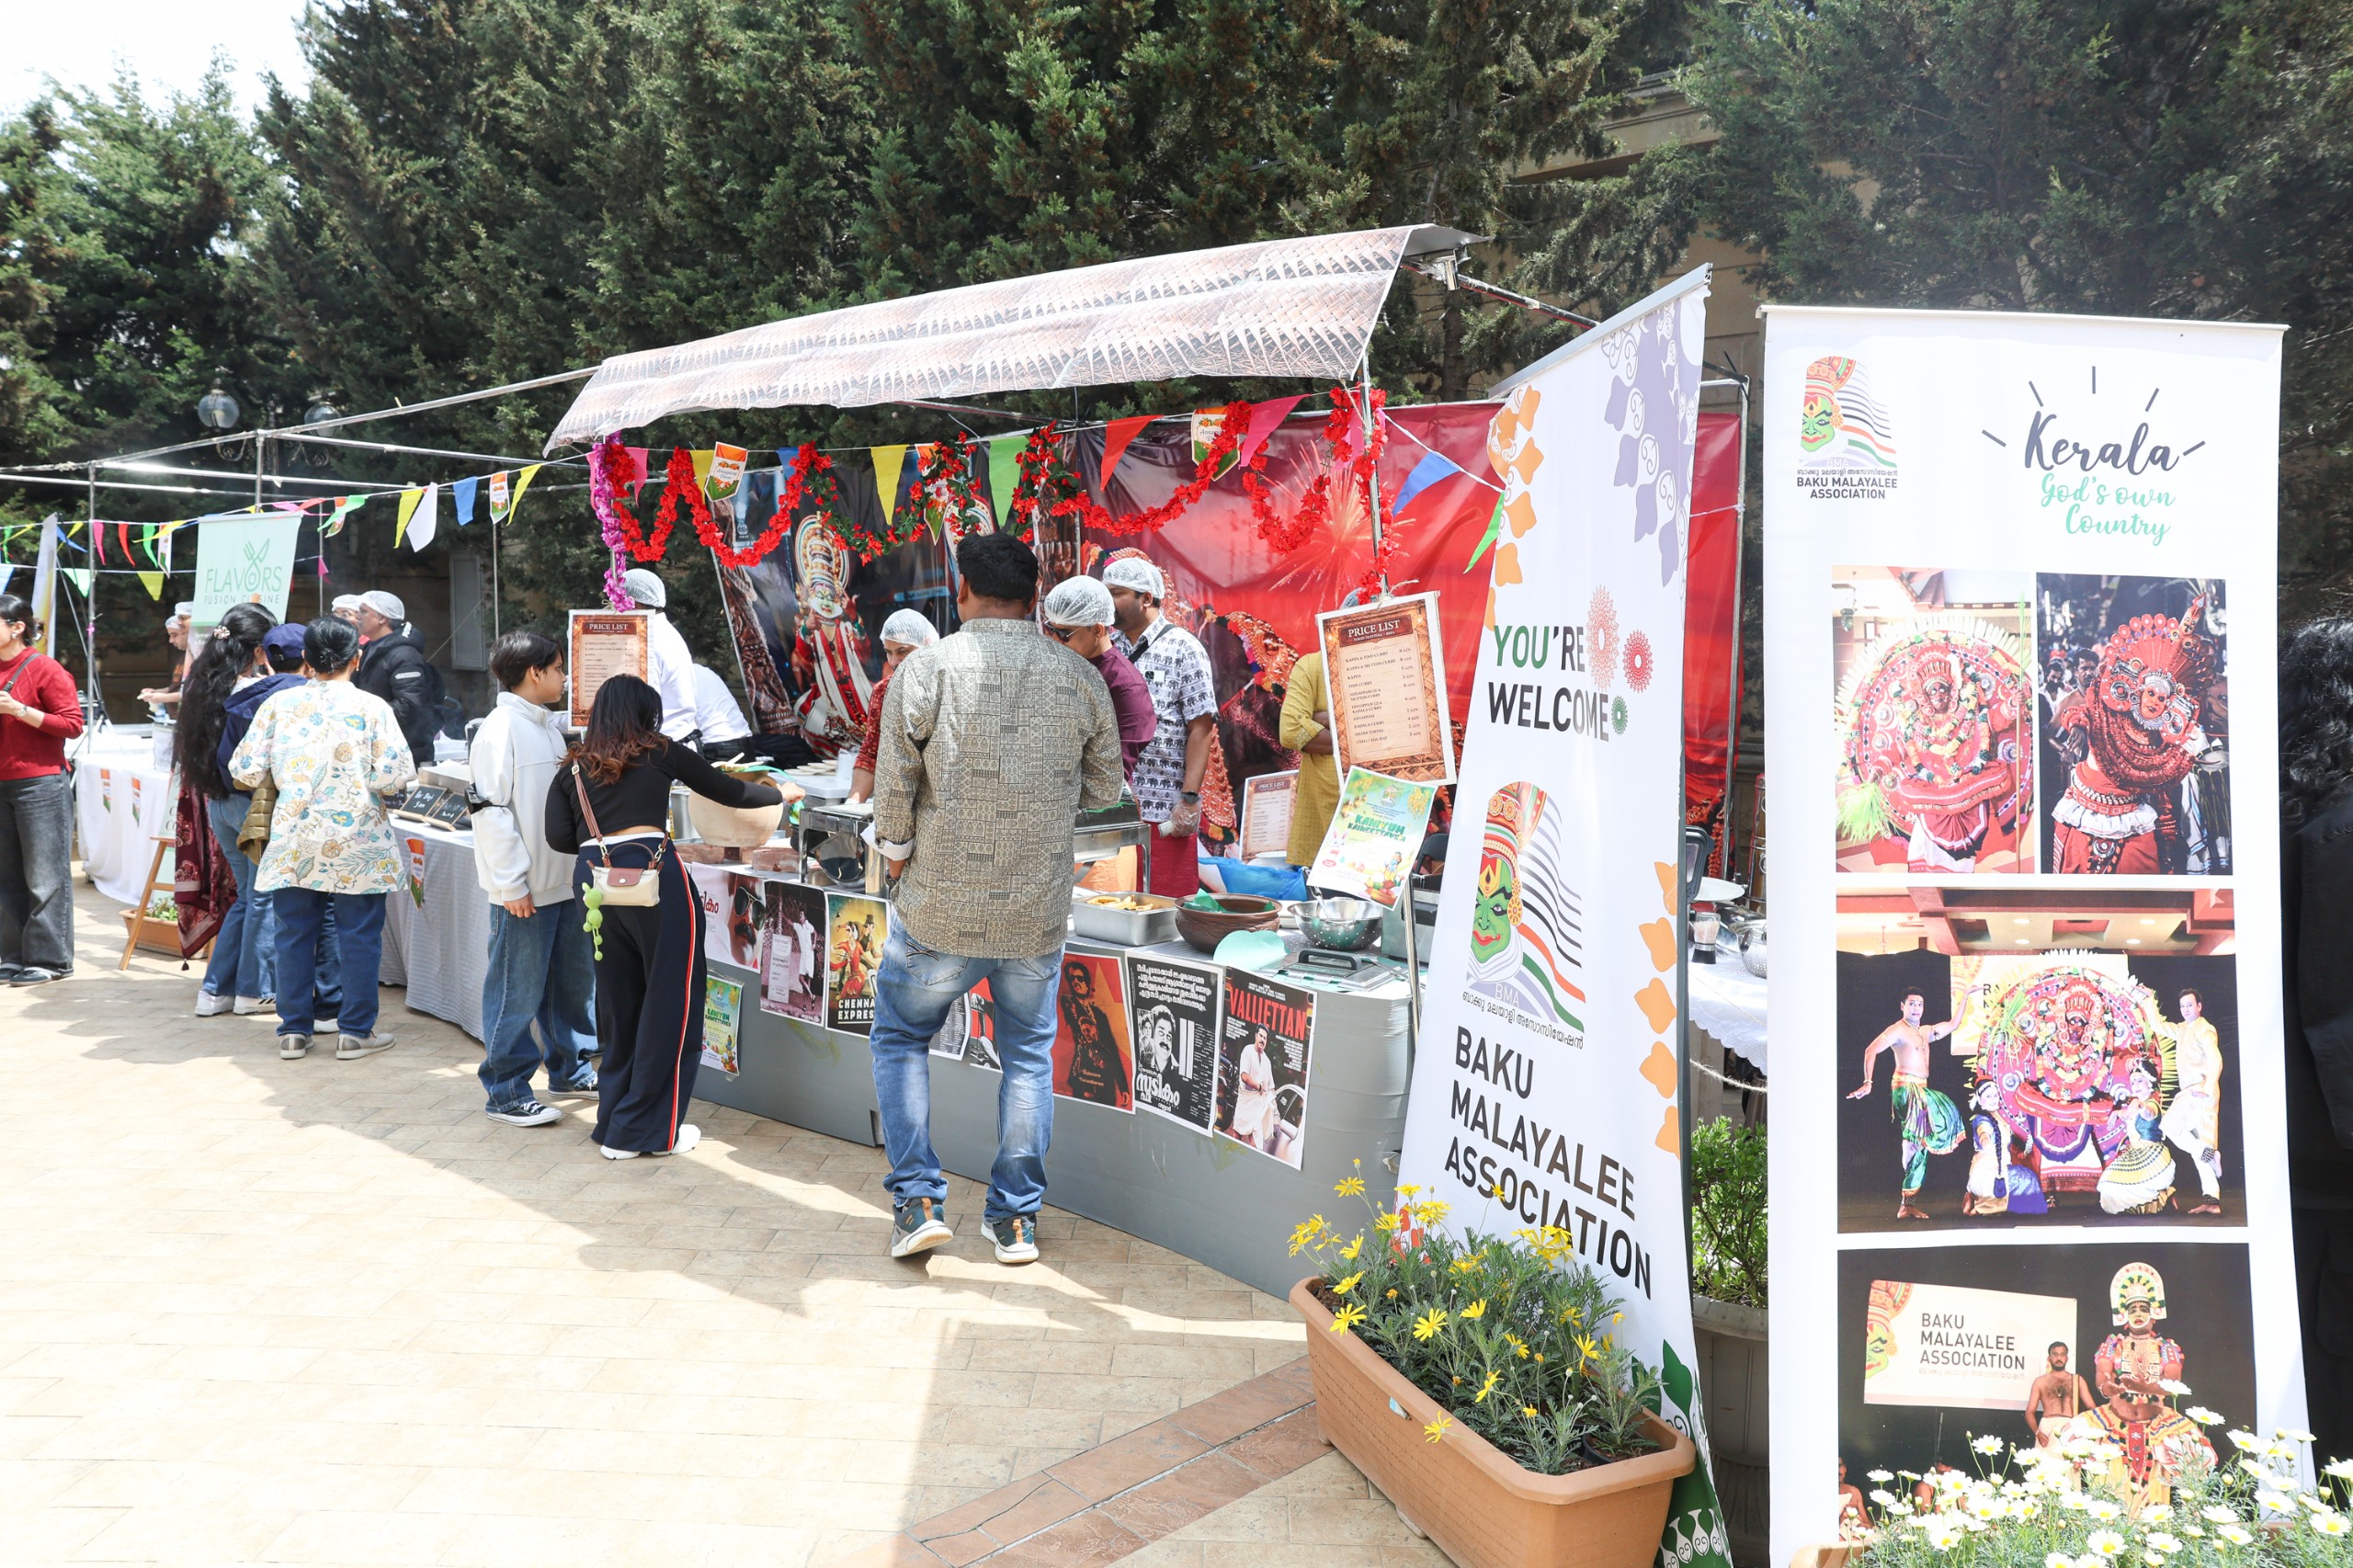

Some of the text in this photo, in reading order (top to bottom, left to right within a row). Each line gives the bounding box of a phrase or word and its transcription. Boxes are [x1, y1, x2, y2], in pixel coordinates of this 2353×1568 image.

[2024, 410, 2180, 476] Kerala
[1797, 477, 1898, 488] BAKU MALAYALEE
[1810, 488, 1886, 499] ASSOCIATION
[2040, 472, 2177, 507] God's own
[2065, 503, 2172, 547] Country
[205, 563, 282, 593] FLAVORS
[204, 594, 236, 605] FUSION
[1347, 619, 1401, 638] PRICE LIST
[1494, 625, 1586, 673] YOU'RE
[1488, 681, 1609, 743] WELCOME
[838, 998, 876, 1009] CHENNA
[1495, 983, 1520, 1008] BMA
[837, 1009, 874, 1020] EXPRES
[1230, 988, 1306, 1041] VALLIETTAN
[1487, 1002, 1516, 1024] മലയാളി
[1517, 1013, 1584, 1050] അസോസിയേഷൻ
[1455, 1025, 1534, 1099] BAKU
[1450, 1079, 1635, 1221] MALAYALEE
[1444, 1136, 1652, 1301] ASSOCIATION
[1921, 1312, 1964, 1329] BAKU
[1920, 1330, 2015, 1351] MALAYALEE
[1919, 1349, 2025, 1370] ASSOCIATION
